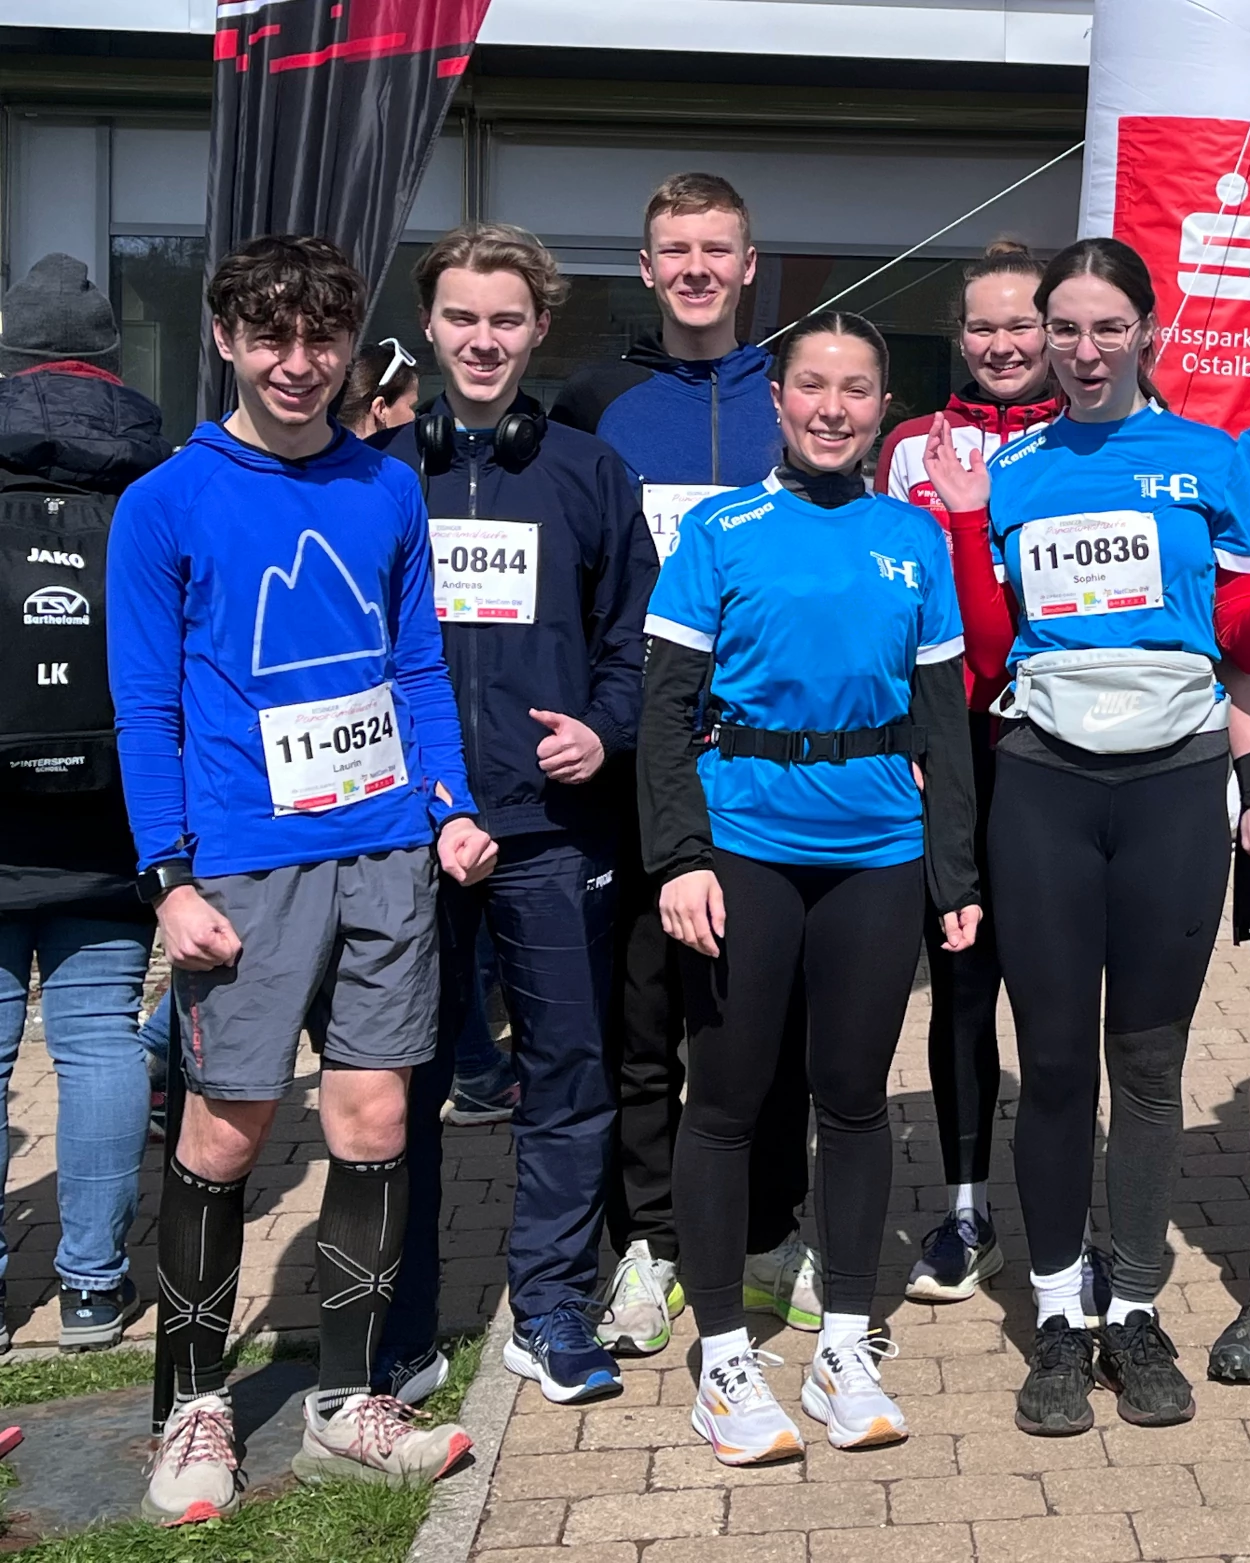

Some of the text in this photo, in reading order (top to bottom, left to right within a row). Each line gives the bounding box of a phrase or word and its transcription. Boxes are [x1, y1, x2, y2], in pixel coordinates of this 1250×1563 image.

[1134, 474, 1198, 501] THG
[719, 502, 775, 531] Kempa
[27, 547, 85, 569] JAKO
[438, 546, 527, 574] -0844
[1029, 534, 1150, 571] 11-0836
[442, 581, 482, 589] Andreas
[1073, 574, 1106, 584] Sophie
[28, 596, 82, 614] TSV
[24, 615, 89, 625] Bartholomä
[37, 662, 68, 685] LK
[1093, 691, 1143, 715] NIKE
[276, 711, 393, 763] 11-0524
[333, 758, 362, 773] Laurin
